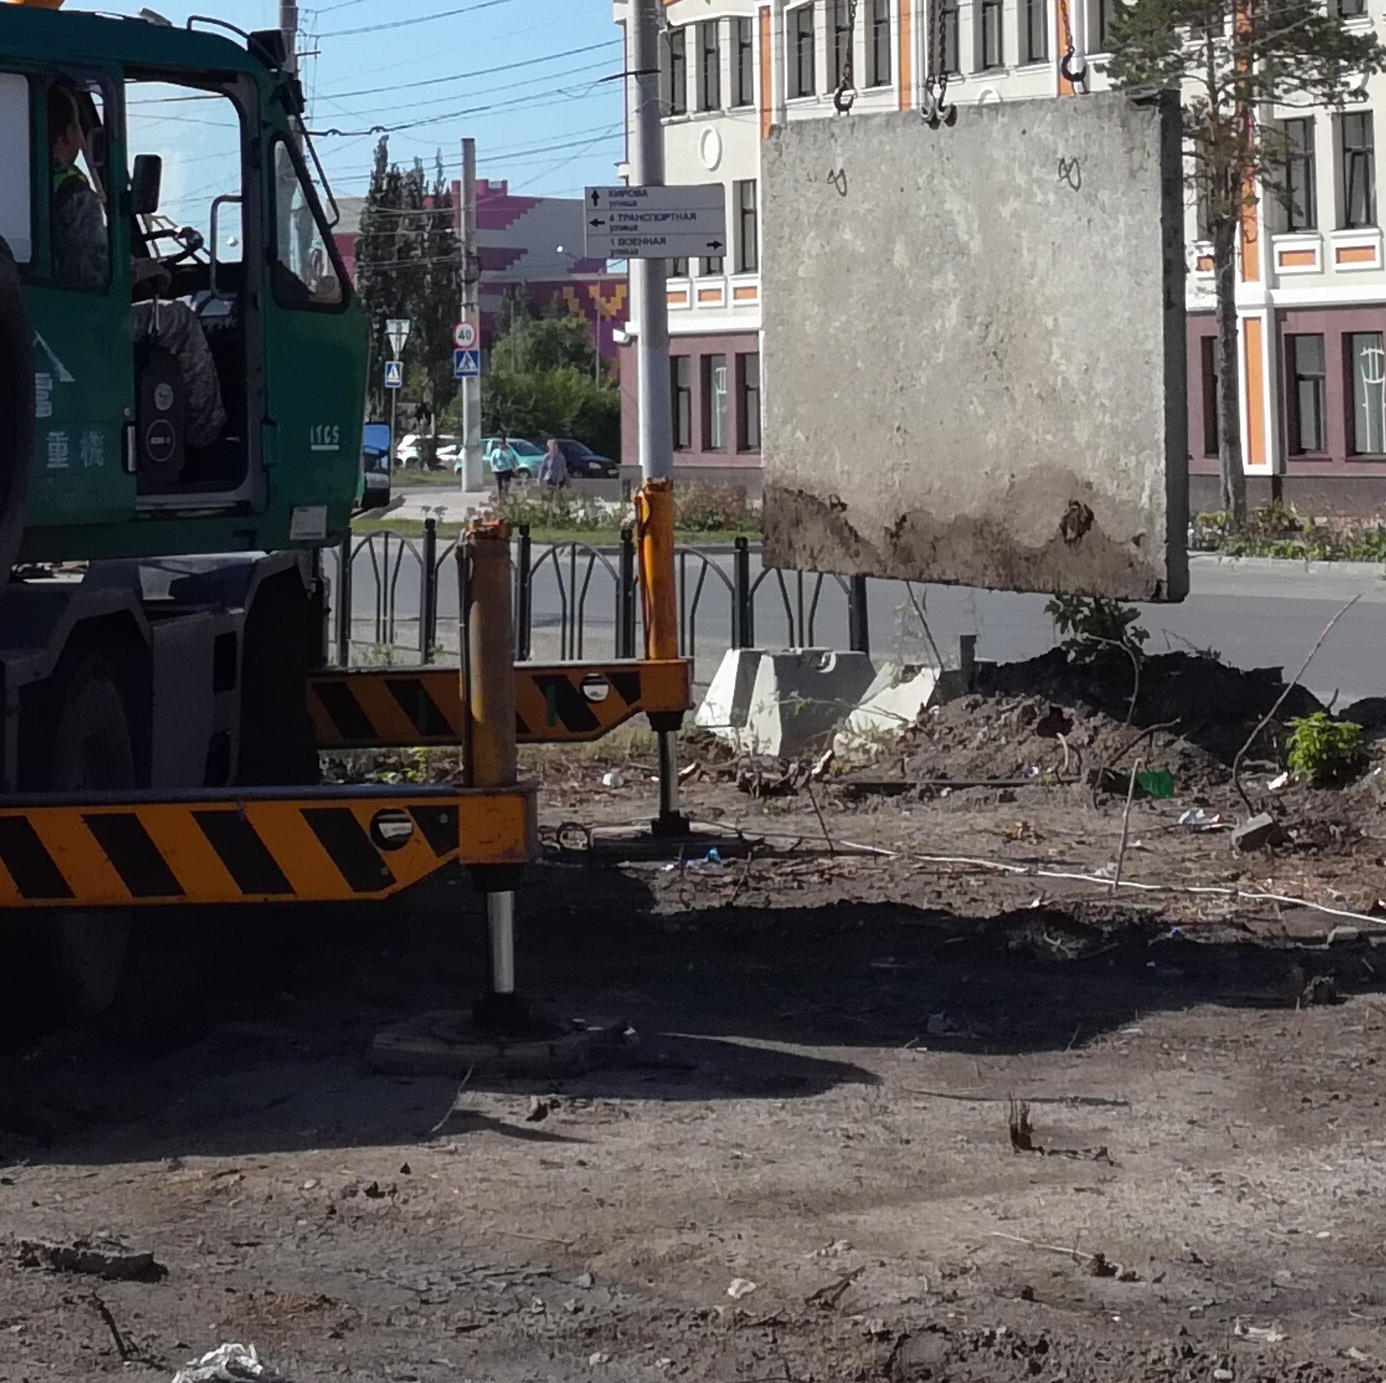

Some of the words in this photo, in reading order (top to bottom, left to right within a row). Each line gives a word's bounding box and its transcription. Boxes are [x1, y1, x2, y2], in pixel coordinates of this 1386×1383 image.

[618, 212, 697, 222] ТРАНСПОРТНАЯ
[618, 237, 667, 246] ВОЕННАЯ
[458, 329, 472, 340] 40
